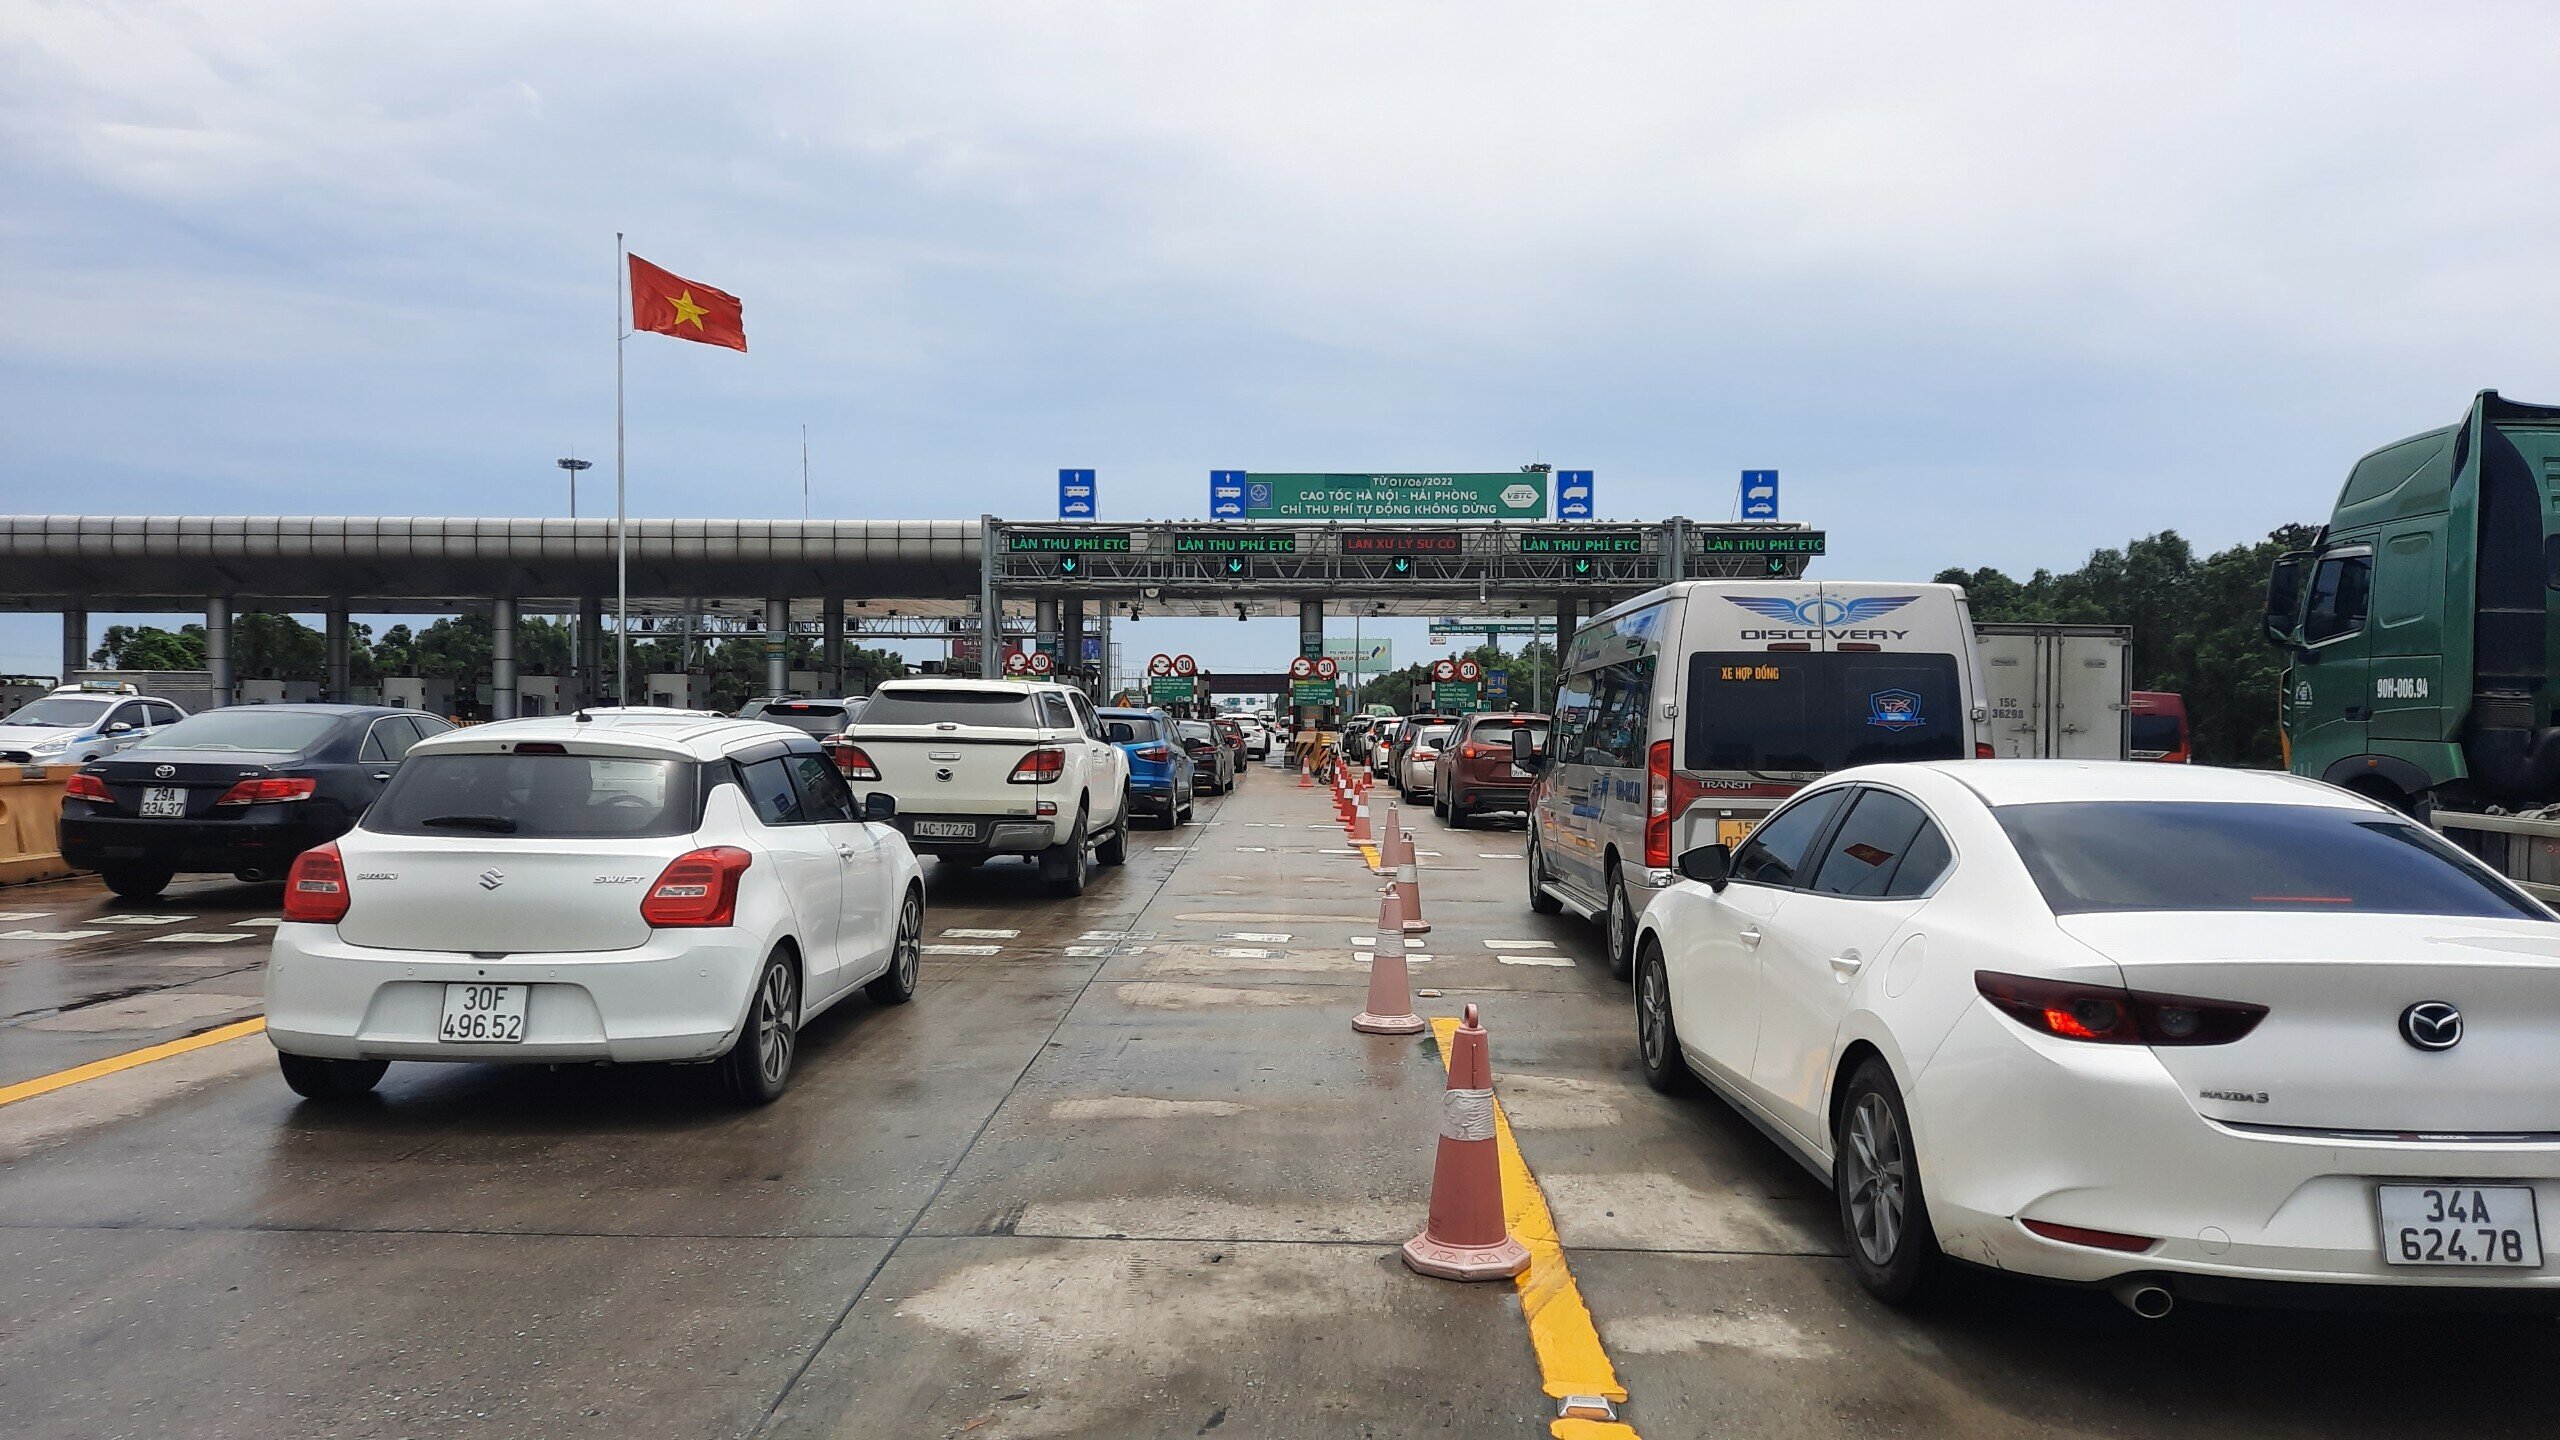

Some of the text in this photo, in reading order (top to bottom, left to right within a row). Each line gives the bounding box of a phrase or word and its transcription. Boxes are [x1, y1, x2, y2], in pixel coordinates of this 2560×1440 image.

[1373, 475, 1453, 487] TỪ 01/06/2022
[1300, 491, 1325, 501] CAO
[1328, 488, 1352, 501] TỐC
[1356, 489, 1373, 501] HÀ
[1376, 489, 1398, 504] NỘI
[1410, 488, 1431, 501] HẢI
[1434, 489, 1478, 501] PHÒNG
[1281, 502, 1302, 514] CHỈ
[1305, 505, 1329, 514] THU
[1333, 502, 1353, 514] PHÍ
[1357, 505, 1373, 517] TỰ
[1376, 502, 1411, 517] ĐỘNG
[1414, 502, 1459, 514] KHÔNG
[1462, 502, 1497, 514] DỪNG
[1011, 535, 1129, 549] LÀN THU PHÍ ETC
[1177, 536, 1294, 550] LÀN THU PHÍ ETC
[1347, 536, 1373, 549] LÀN
[1523, 536, 1639, 550] LÀN THU PHÍ ETC
[1707, 536, 1823, 550] LÀN THU PHÍ ETC
[1741, 630, 1909, 640] DISCOVERY
[1035, 657, 1046, 667] 30
[1179, 661, 1190, 670] 30
[1321, 663, 1332, 673] 30
[1464, 666, 1474, 675] 30
[1721, 667, 1733, 679] XE
[1736, 667, 1752, 682] HỢP
[2377, 678, 2428, 698] 90H-006.94
[154, 789, 174, 801] 29A
[143, 803, 183, 814] 334.37
[356, 872, 398, 880] SUZUKI
[593, 875, 645, 883] SWIFT
[463, 987, 508, 1010] 30F
[443, 1015, 521, 1039] 496.52
[2423, 1190, 2490, 1224] 34A
[2400, 1229, 2523, 1262] 624.78
